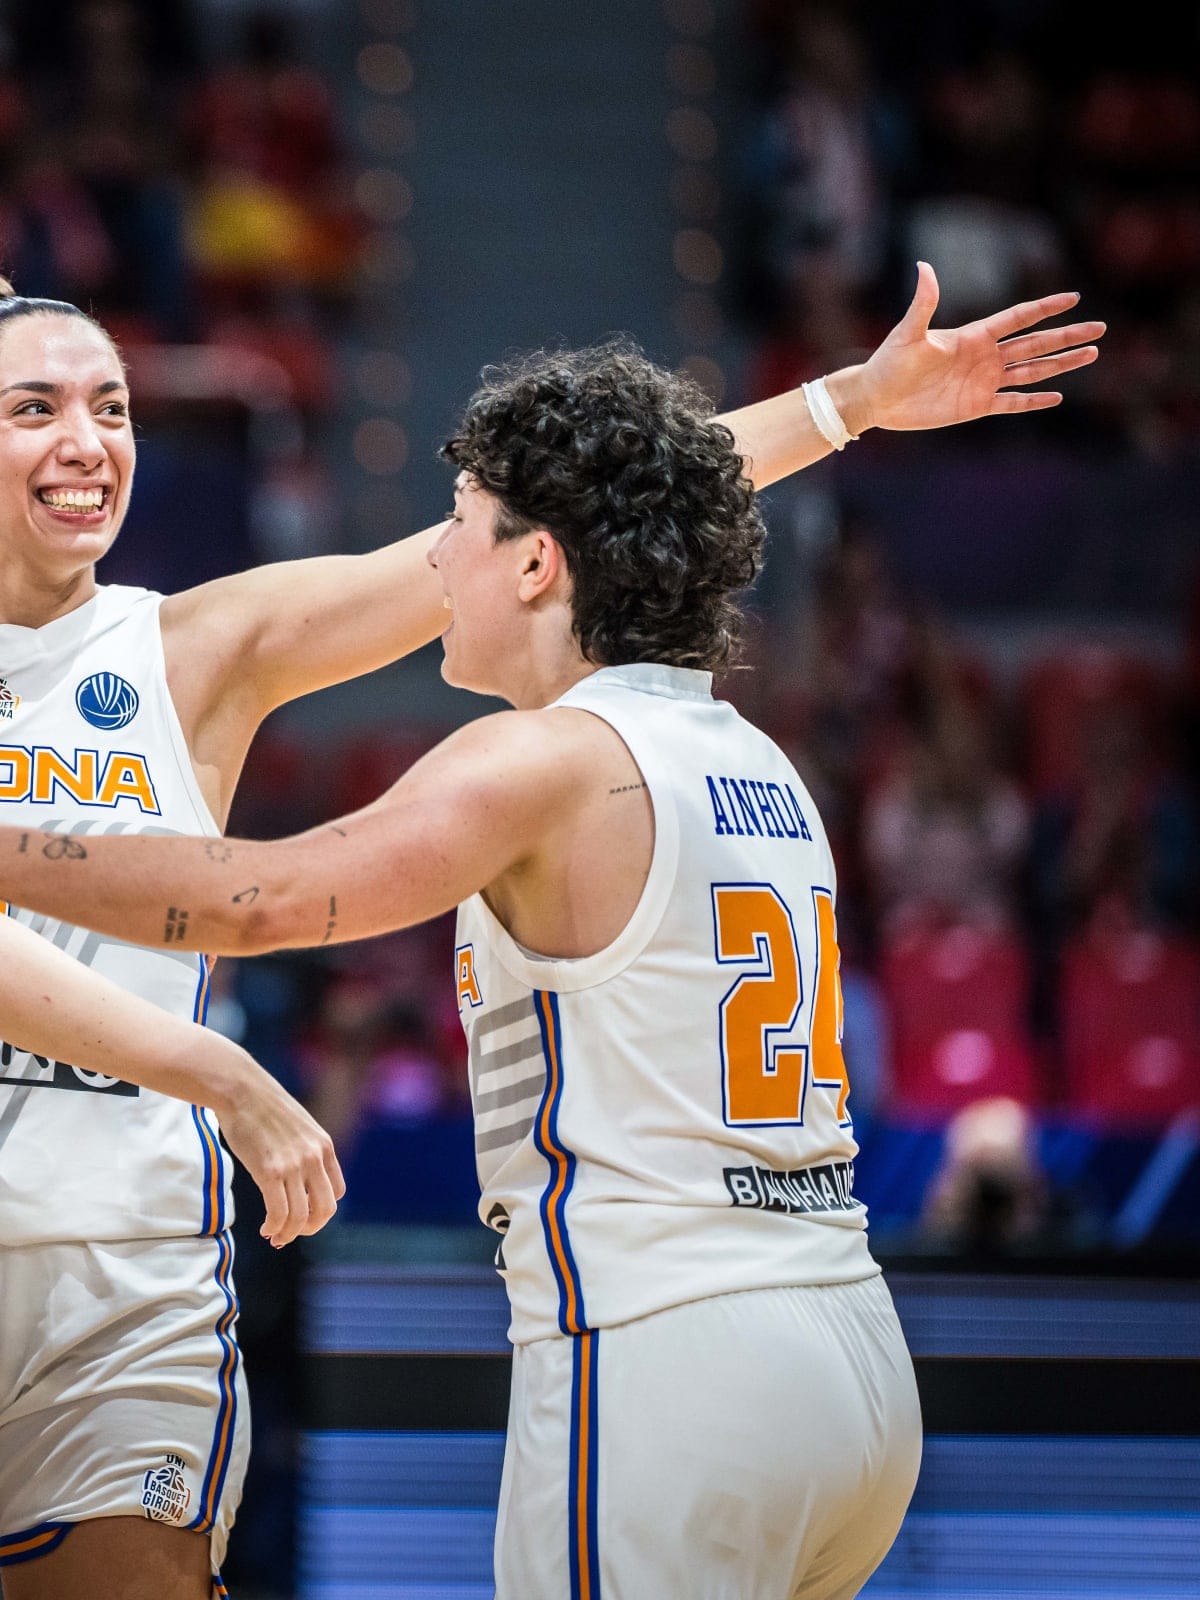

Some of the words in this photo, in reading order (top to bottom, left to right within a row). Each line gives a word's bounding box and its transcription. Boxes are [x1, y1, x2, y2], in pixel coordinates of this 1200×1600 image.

[706, 775, 813, 842] AINHOA
[730, 1169, 854, 1207] BAUHAU
[166, 1455, 185, 1469] UNI
[143, 1491, 184, 1521] GIRONA
[150, 1481, 186, 1503] BASQUET
